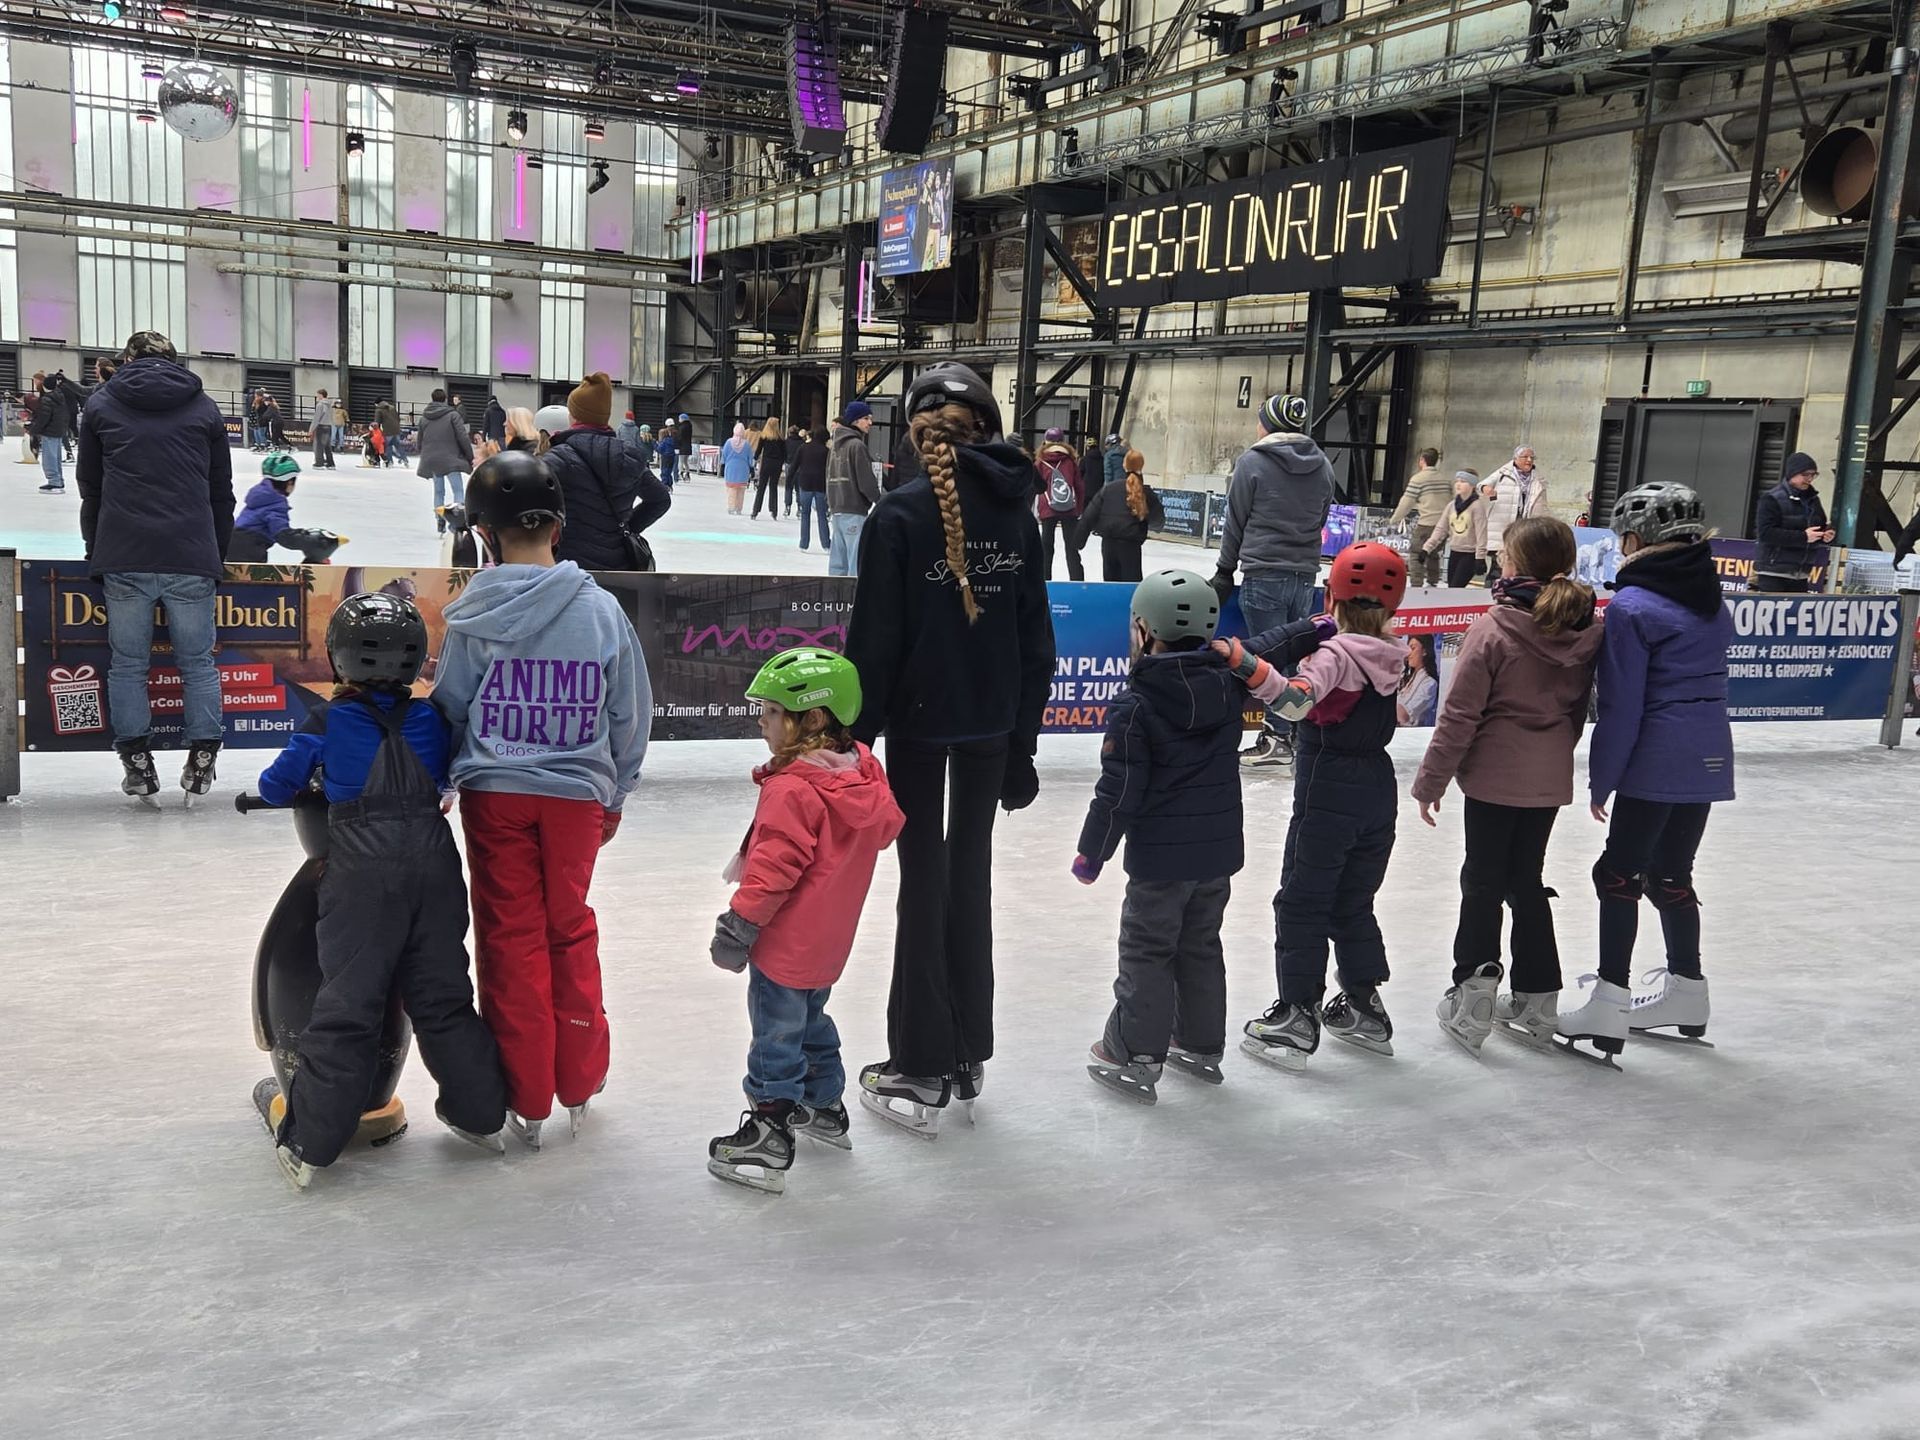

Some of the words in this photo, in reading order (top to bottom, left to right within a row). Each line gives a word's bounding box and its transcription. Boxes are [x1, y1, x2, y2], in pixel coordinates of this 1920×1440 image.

[966, 541, 998, 550] NLINE
[1409, 615, 1431, 627] ALL
[1724, 599, 1898, 637] ORT-EVENTS
[1769, 645, 1826, 659] EISLAUFEN
[1837, 645, 1894, 659] EISHOCKEY
[232, 671, 259, 681] Uhr
[1727, 664, 1763, 678] IRMEN
[1775, 664, 1824, 678] GRUPPEN
[480, 658, 601, 704] ANIMO
[223, 693, 278, 705] Bochum
[667, 703, 706, 717] Zimmer
[708, 703, 724, 716] für
[749, 704, 763, 715] Dri
[251, 719, 295, 732] Liberi
[479, 702, 598, 746] FORTE
